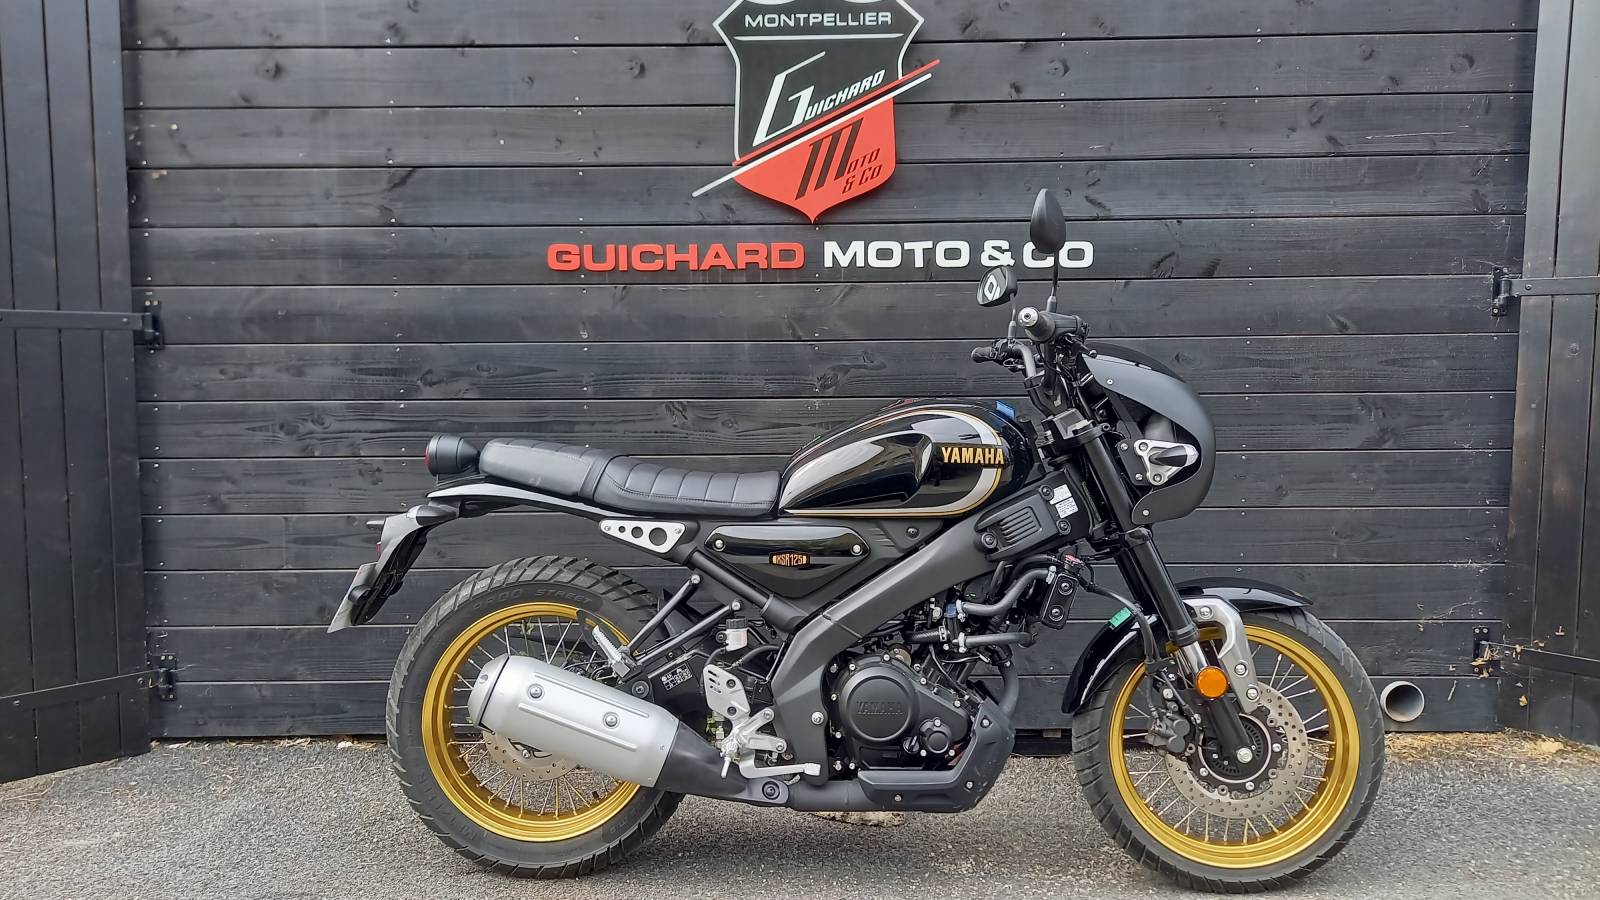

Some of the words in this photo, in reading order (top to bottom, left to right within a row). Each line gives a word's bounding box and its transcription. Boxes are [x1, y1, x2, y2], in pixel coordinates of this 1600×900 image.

[744, 11, 893, 29] MONTPELLIER
[752, 51, 886, 148] GUICHARD
[547, 242, 806, 272] GUICHARD
[823, 240, 971, 269] MOTO
[980, 239, 1016, 267] &
[1022, 241, 1094, 269] CO
[941, 446, 1005, 465] YAMAHA
